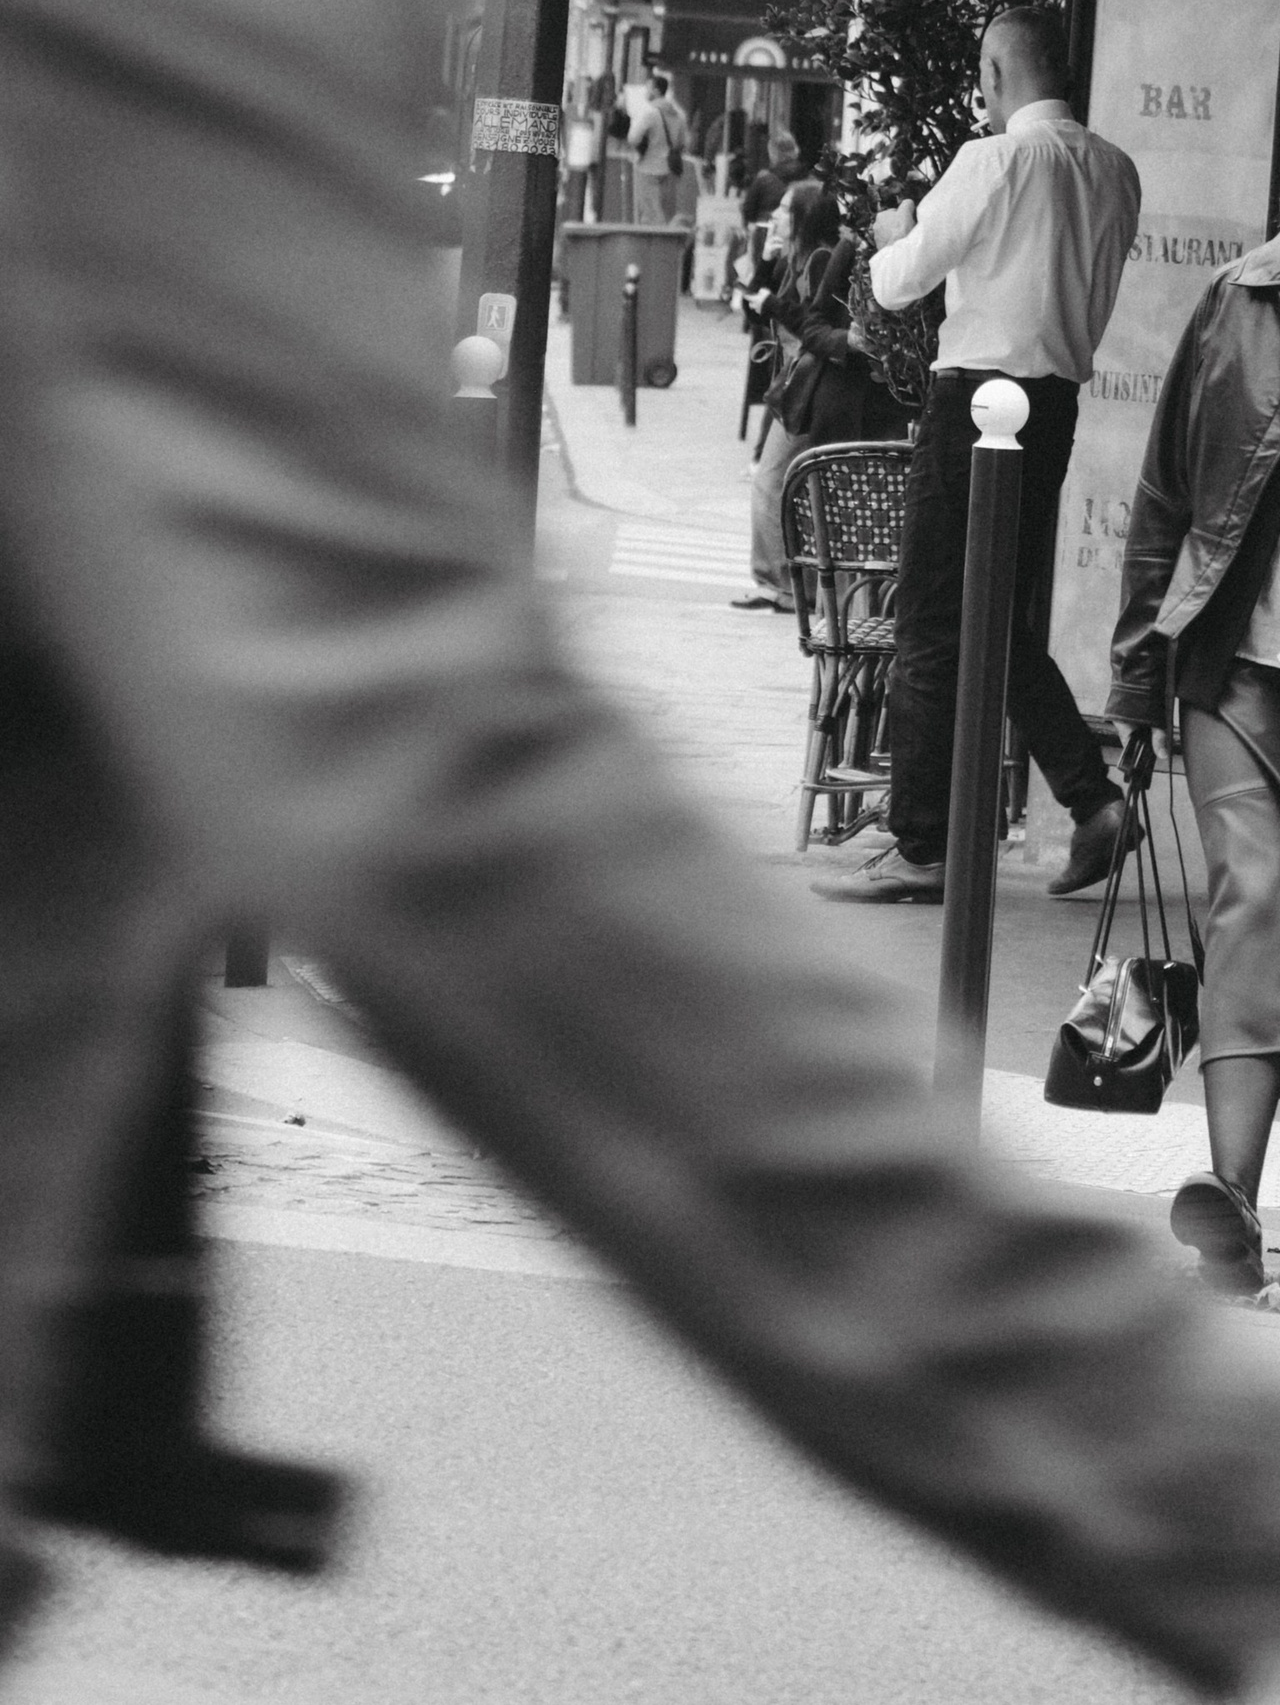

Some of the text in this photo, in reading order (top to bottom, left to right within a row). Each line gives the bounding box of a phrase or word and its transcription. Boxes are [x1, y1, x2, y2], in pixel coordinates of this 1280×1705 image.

[1140, 83, 1213, 121] BAR
[476, 108, 558, 121] COURS INDIVIDUELS
[474, 115, 557, 133] ALLEMAND
